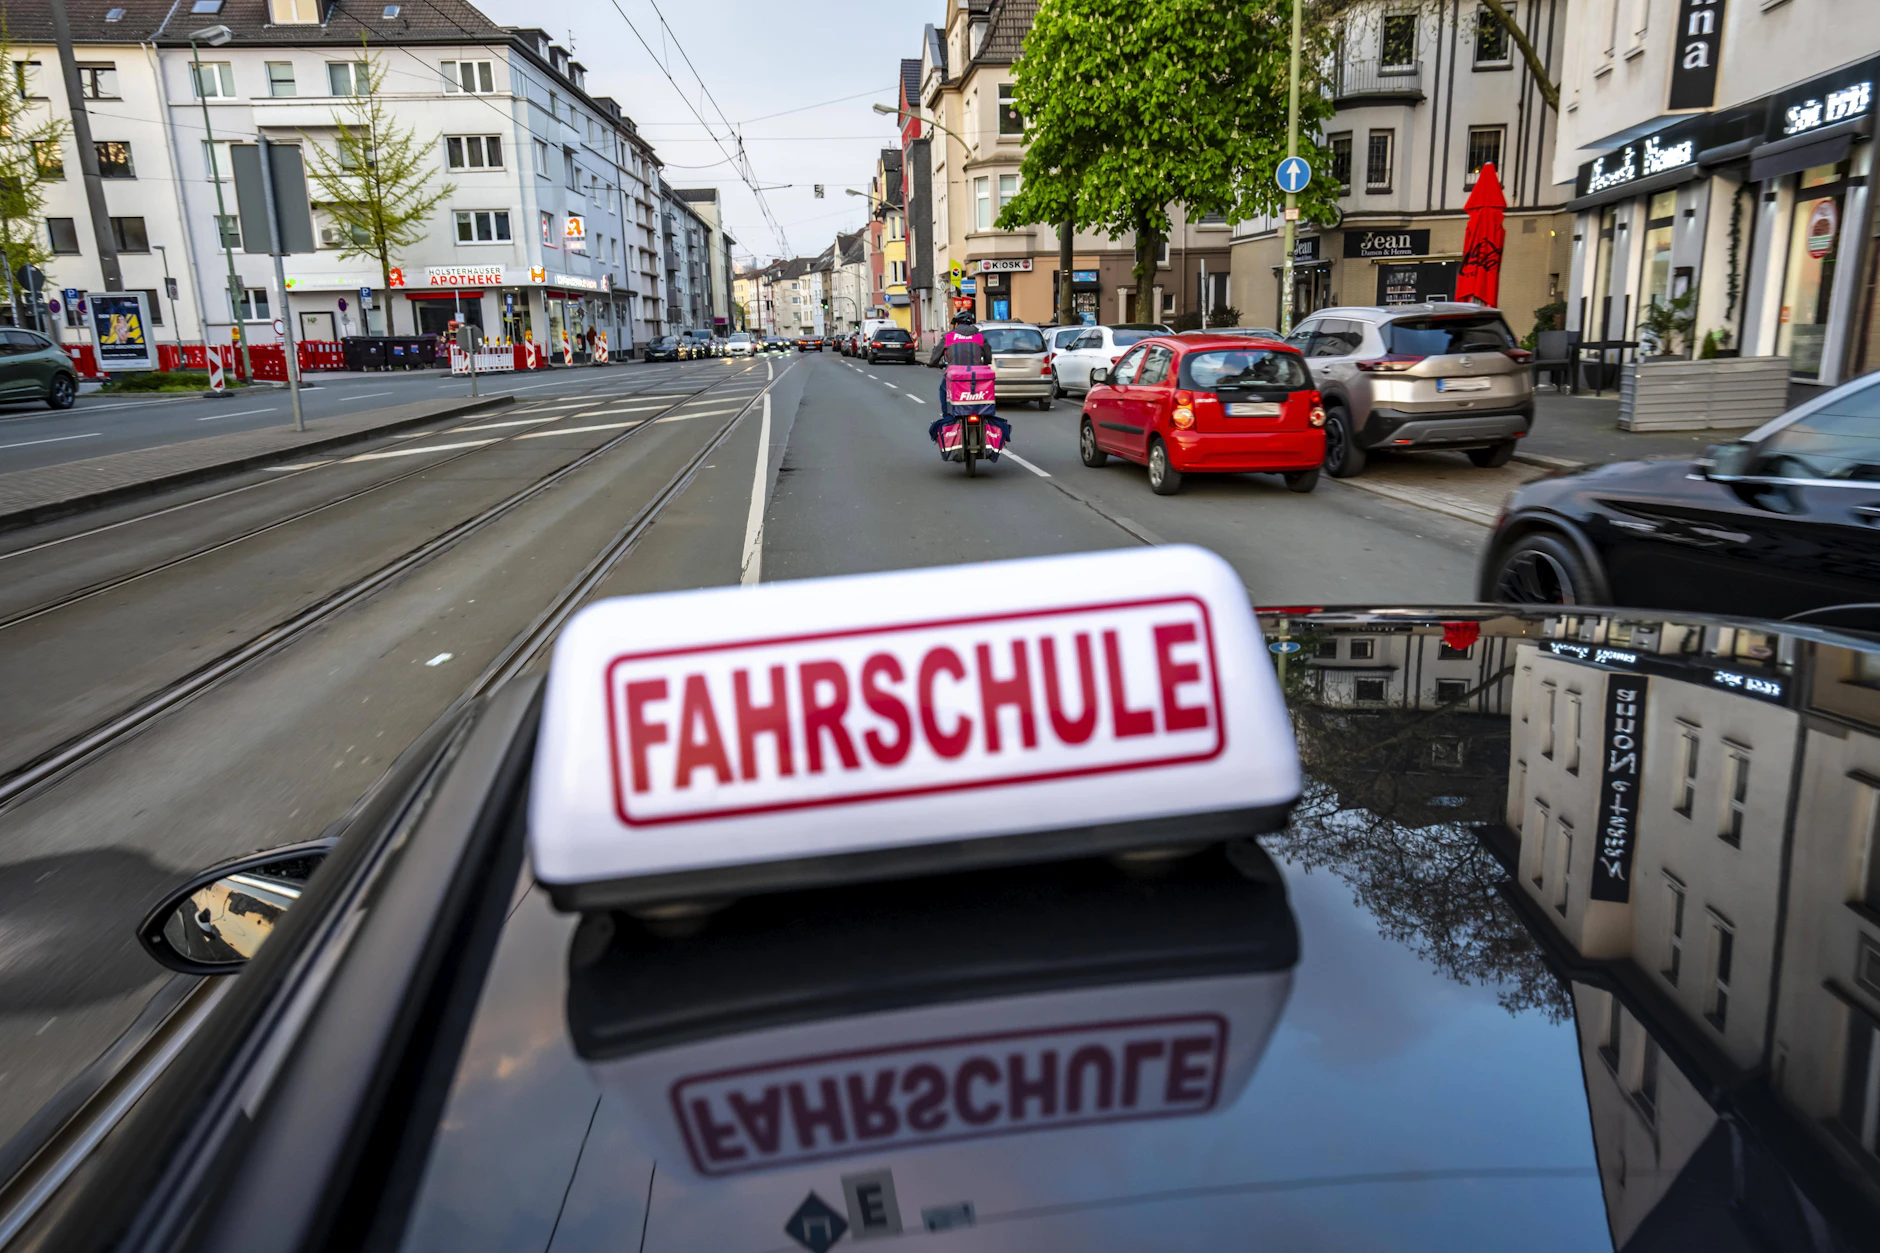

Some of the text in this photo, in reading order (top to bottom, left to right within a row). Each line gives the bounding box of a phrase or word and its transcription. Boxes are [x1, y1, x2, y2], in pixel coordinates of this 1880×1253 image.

[1683, 0, 1718, 69] na
[1360, 231, 1412, 249] Jean
[1390, 248, 1412, 256] Herren
[992, 261, 1021, 269] KIOSK
[428, 267, 501, 276] HOLSTERHAUSER
[430, 274, 502, 286] APOTHEKE
[959, 390, 986, 401] Flink
[624, 621, 1209, 794] FAHRSCHULE
